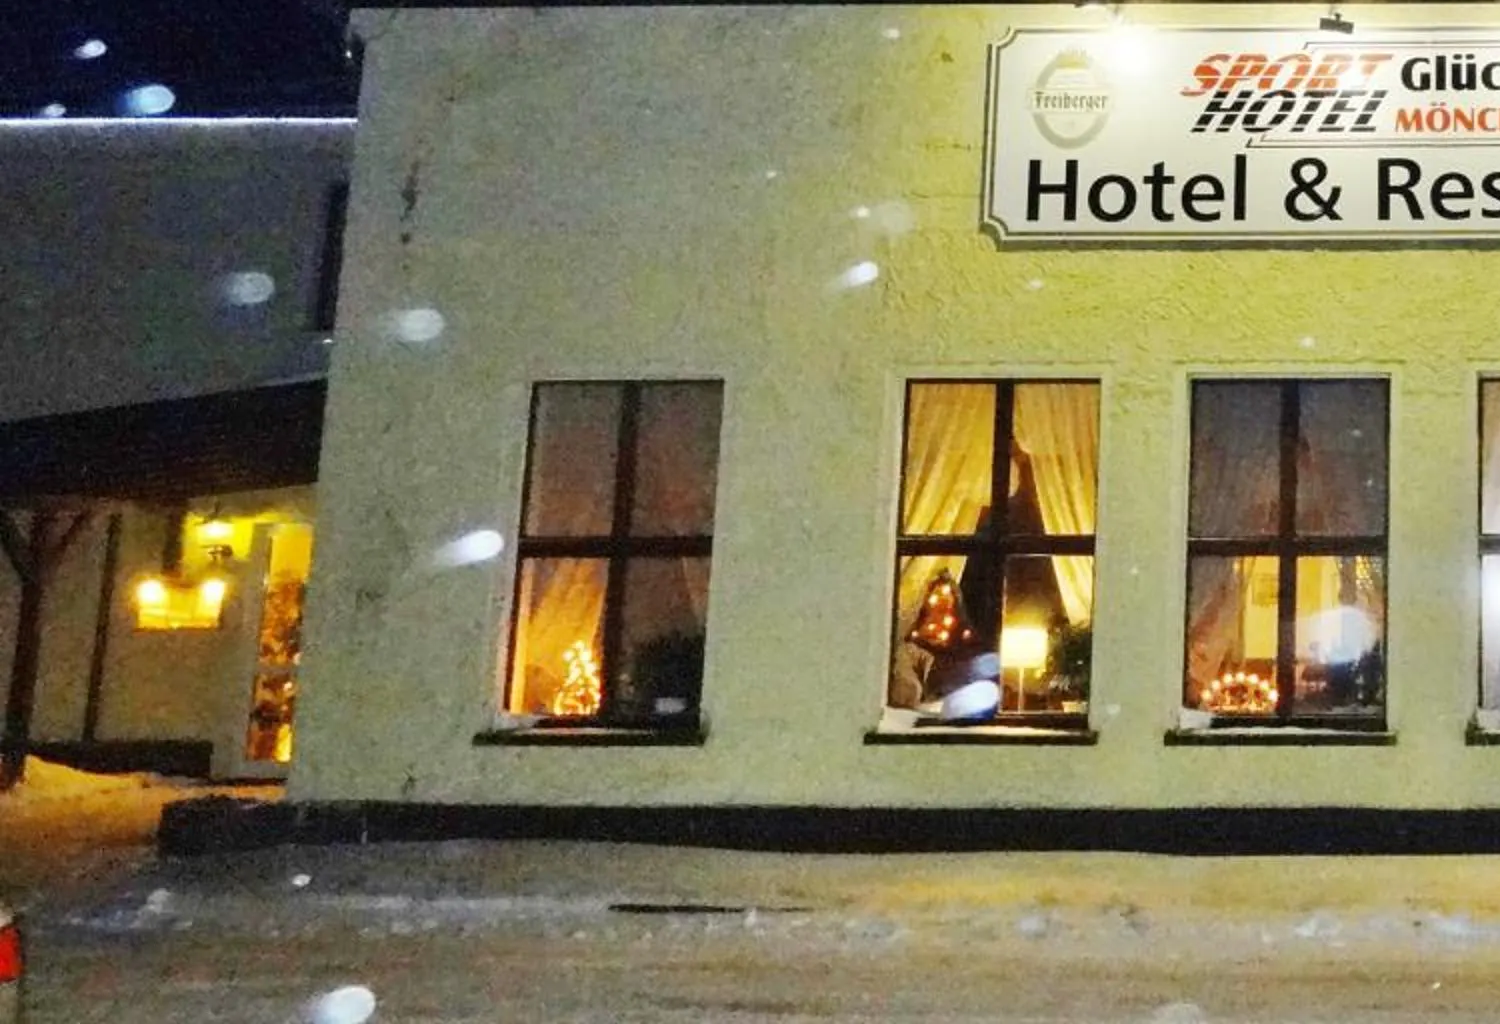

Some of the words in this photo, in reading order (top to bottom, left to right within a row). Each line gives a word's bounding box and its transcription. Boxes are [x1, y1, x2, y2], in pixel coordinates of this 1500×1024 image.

[1180, 53, 1394, 97] SPORT
[1033, 91, 1109, 112] Freiberger
[1190, 89, 1388, 133] HOTEL
[1026, 153, 1247, 223] Hotel
[1284, 157, 1343, 222] &
